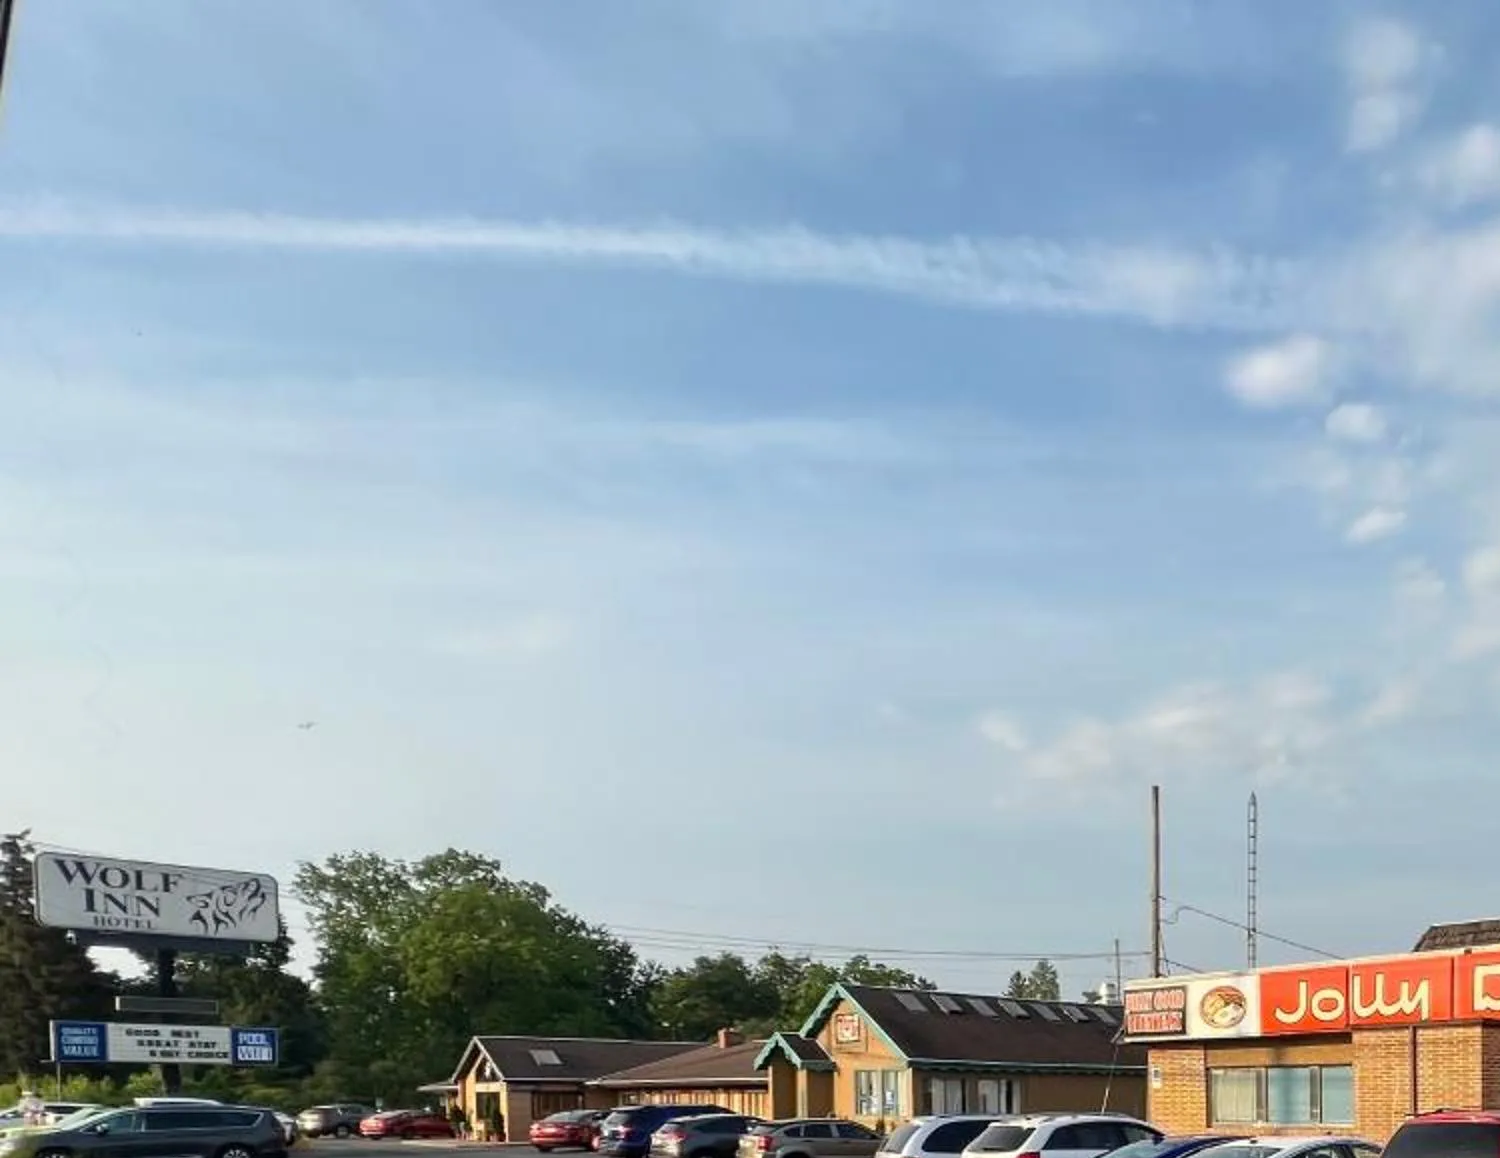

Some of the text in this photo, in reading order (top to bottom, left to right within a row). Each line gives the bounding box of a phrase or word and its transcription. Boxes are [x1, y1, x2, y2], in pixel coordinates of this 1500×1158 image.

[53, 859, 183, 893] WOLF
[83, 887, 160, 917] INN
[93, 915, 156, 930] HOTEL
[1274, 972, 1430, 1024] Jolly
[63, 1046, 99, 1057] VALUE
